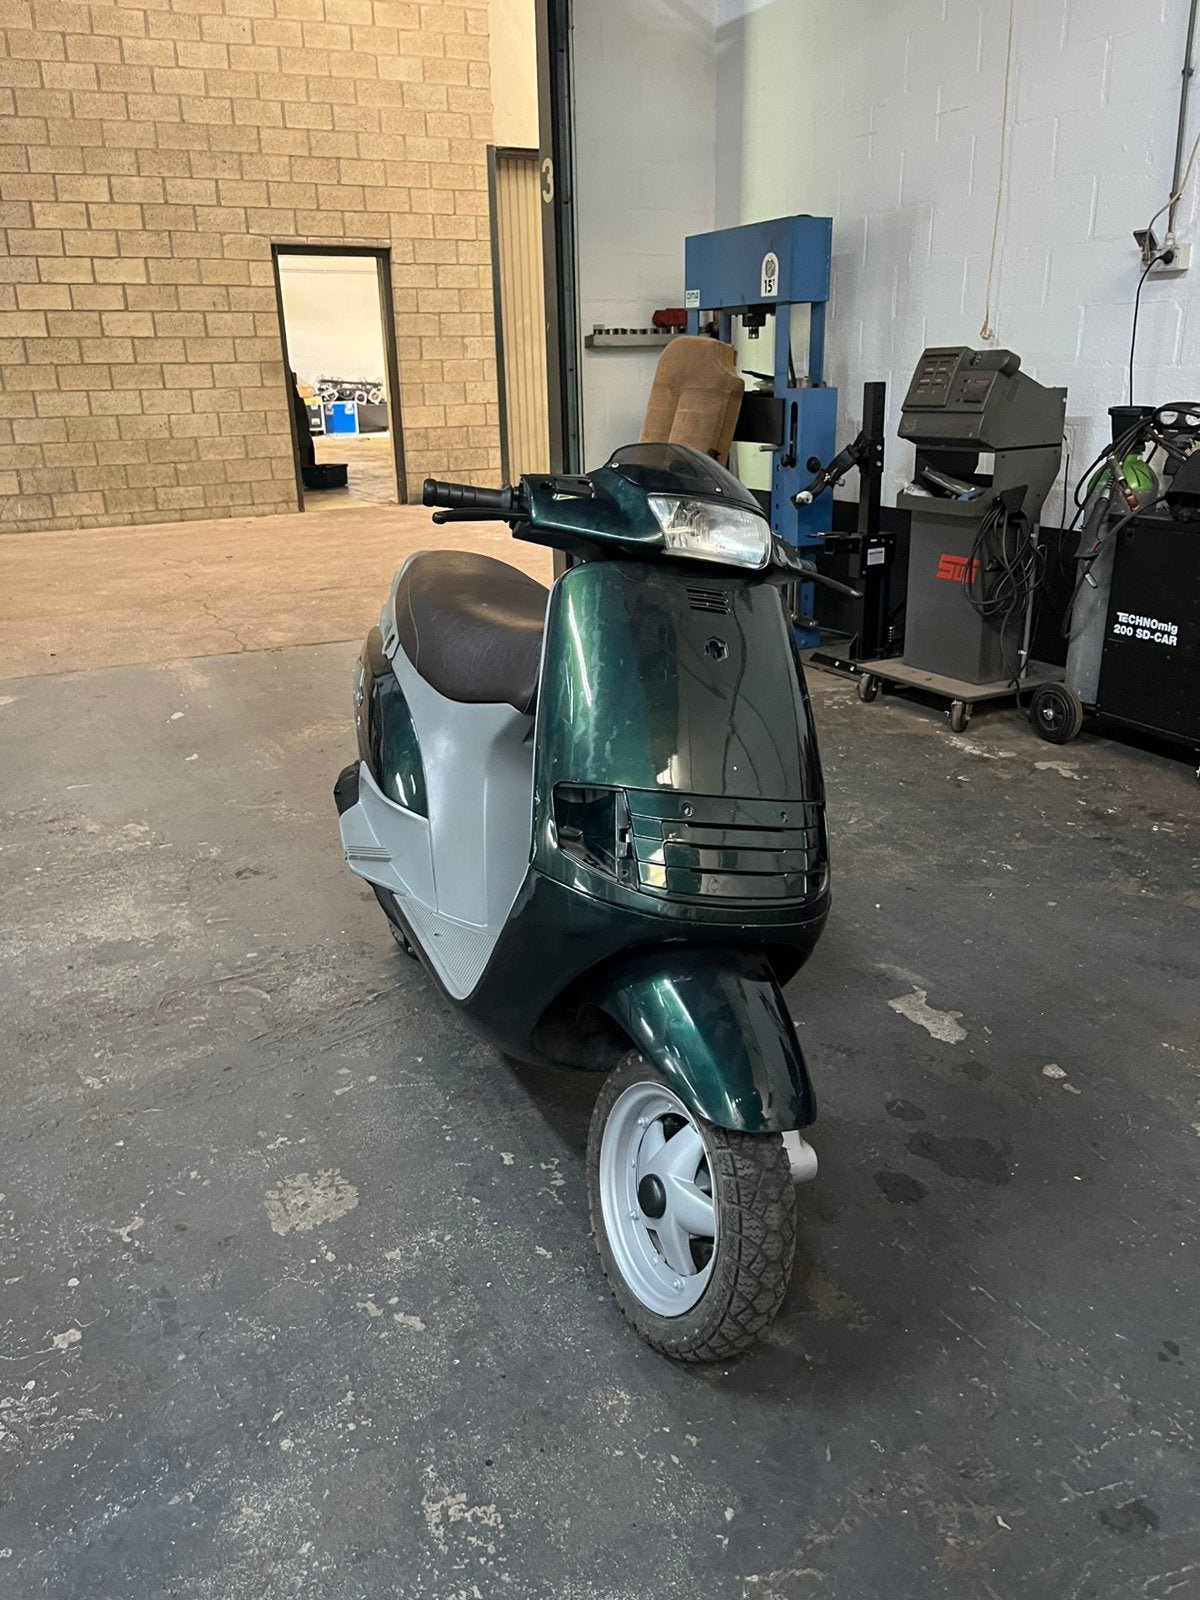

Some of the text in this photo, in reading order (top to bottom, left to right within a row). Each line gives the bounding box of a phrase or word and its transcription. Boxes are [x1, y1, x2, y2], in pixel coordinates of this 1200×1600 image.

[542, 157, 554, 203] 3
[1113, 623, 1178, 647] 200 SD-CAR
